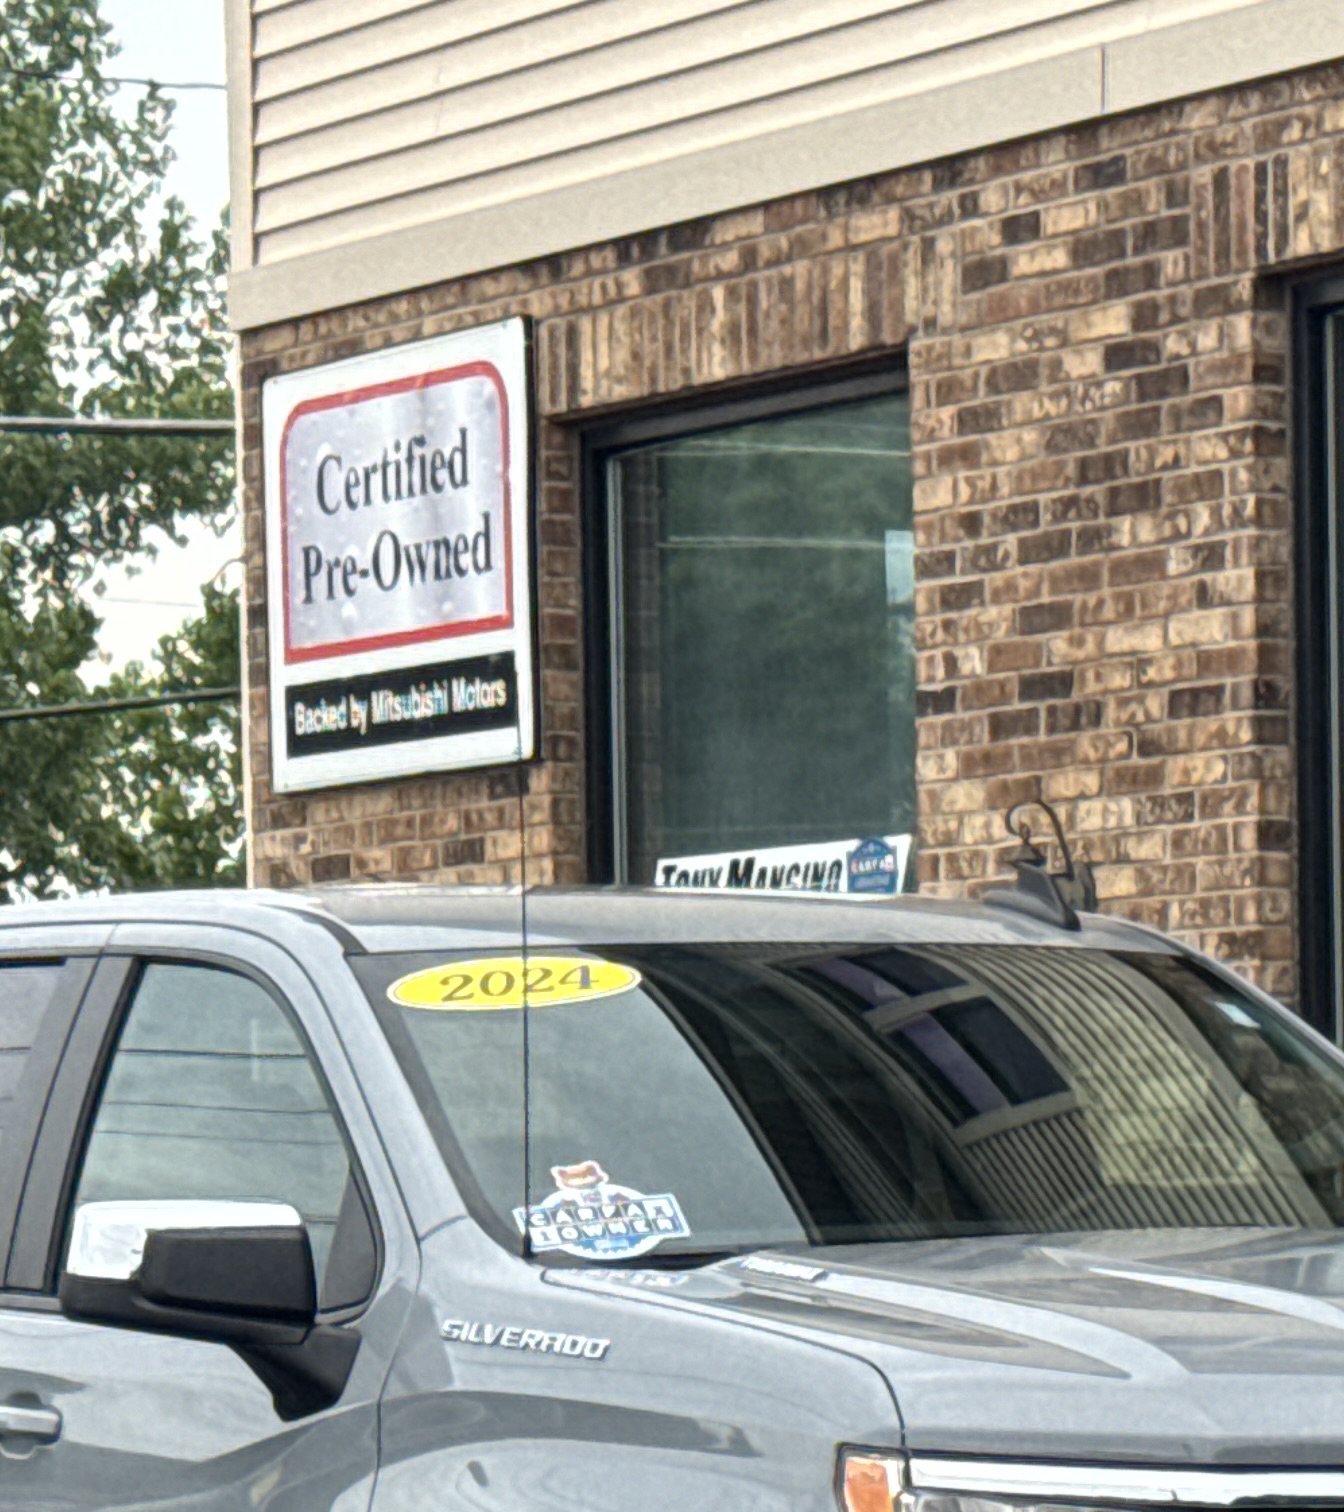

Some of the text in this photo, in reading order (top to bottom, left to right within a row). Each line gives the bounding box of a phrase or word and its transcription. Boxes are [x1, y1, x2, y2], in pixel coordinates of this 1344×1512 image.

[317, 427, 469, 515] Certified
[302, 511, 493, 604] Pre-Owned
[294, 676, 506, 736] Backed by Mitsubishi Motors
[439, 965, 600, 1003] 2024
[441, 1319, 611, 1360] SILVERADO
